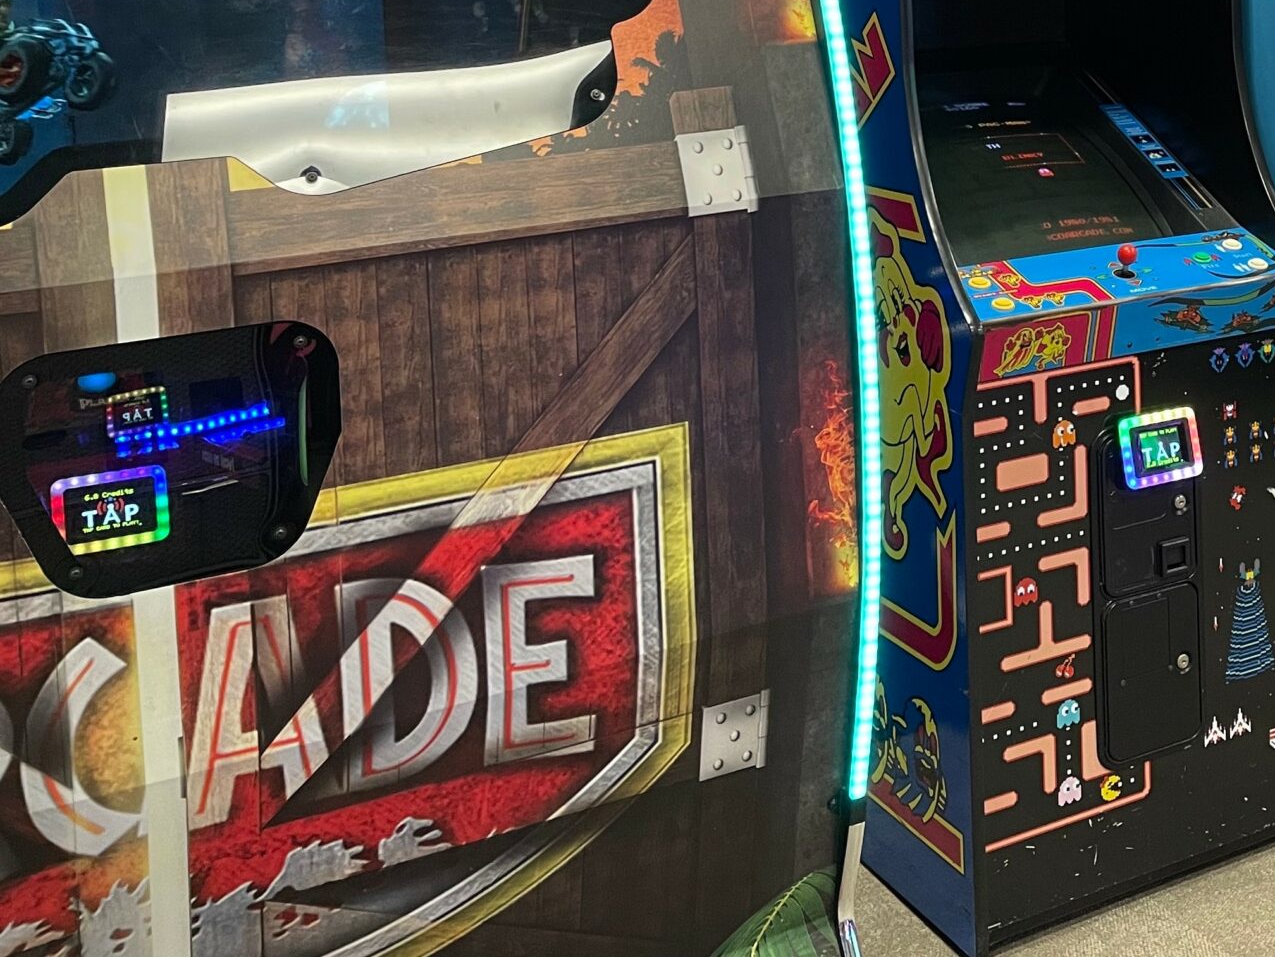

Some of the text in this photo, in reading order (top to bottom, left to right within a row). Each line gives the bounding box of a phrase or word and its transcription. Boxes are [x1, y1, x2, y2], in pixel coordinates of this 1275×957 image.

[1141, 442, 1180, 463] TAP
[101, 488, 134, 499] Credits
[81, 503, 140, 529] TAP
[0, 554, 597, 856] CADE
